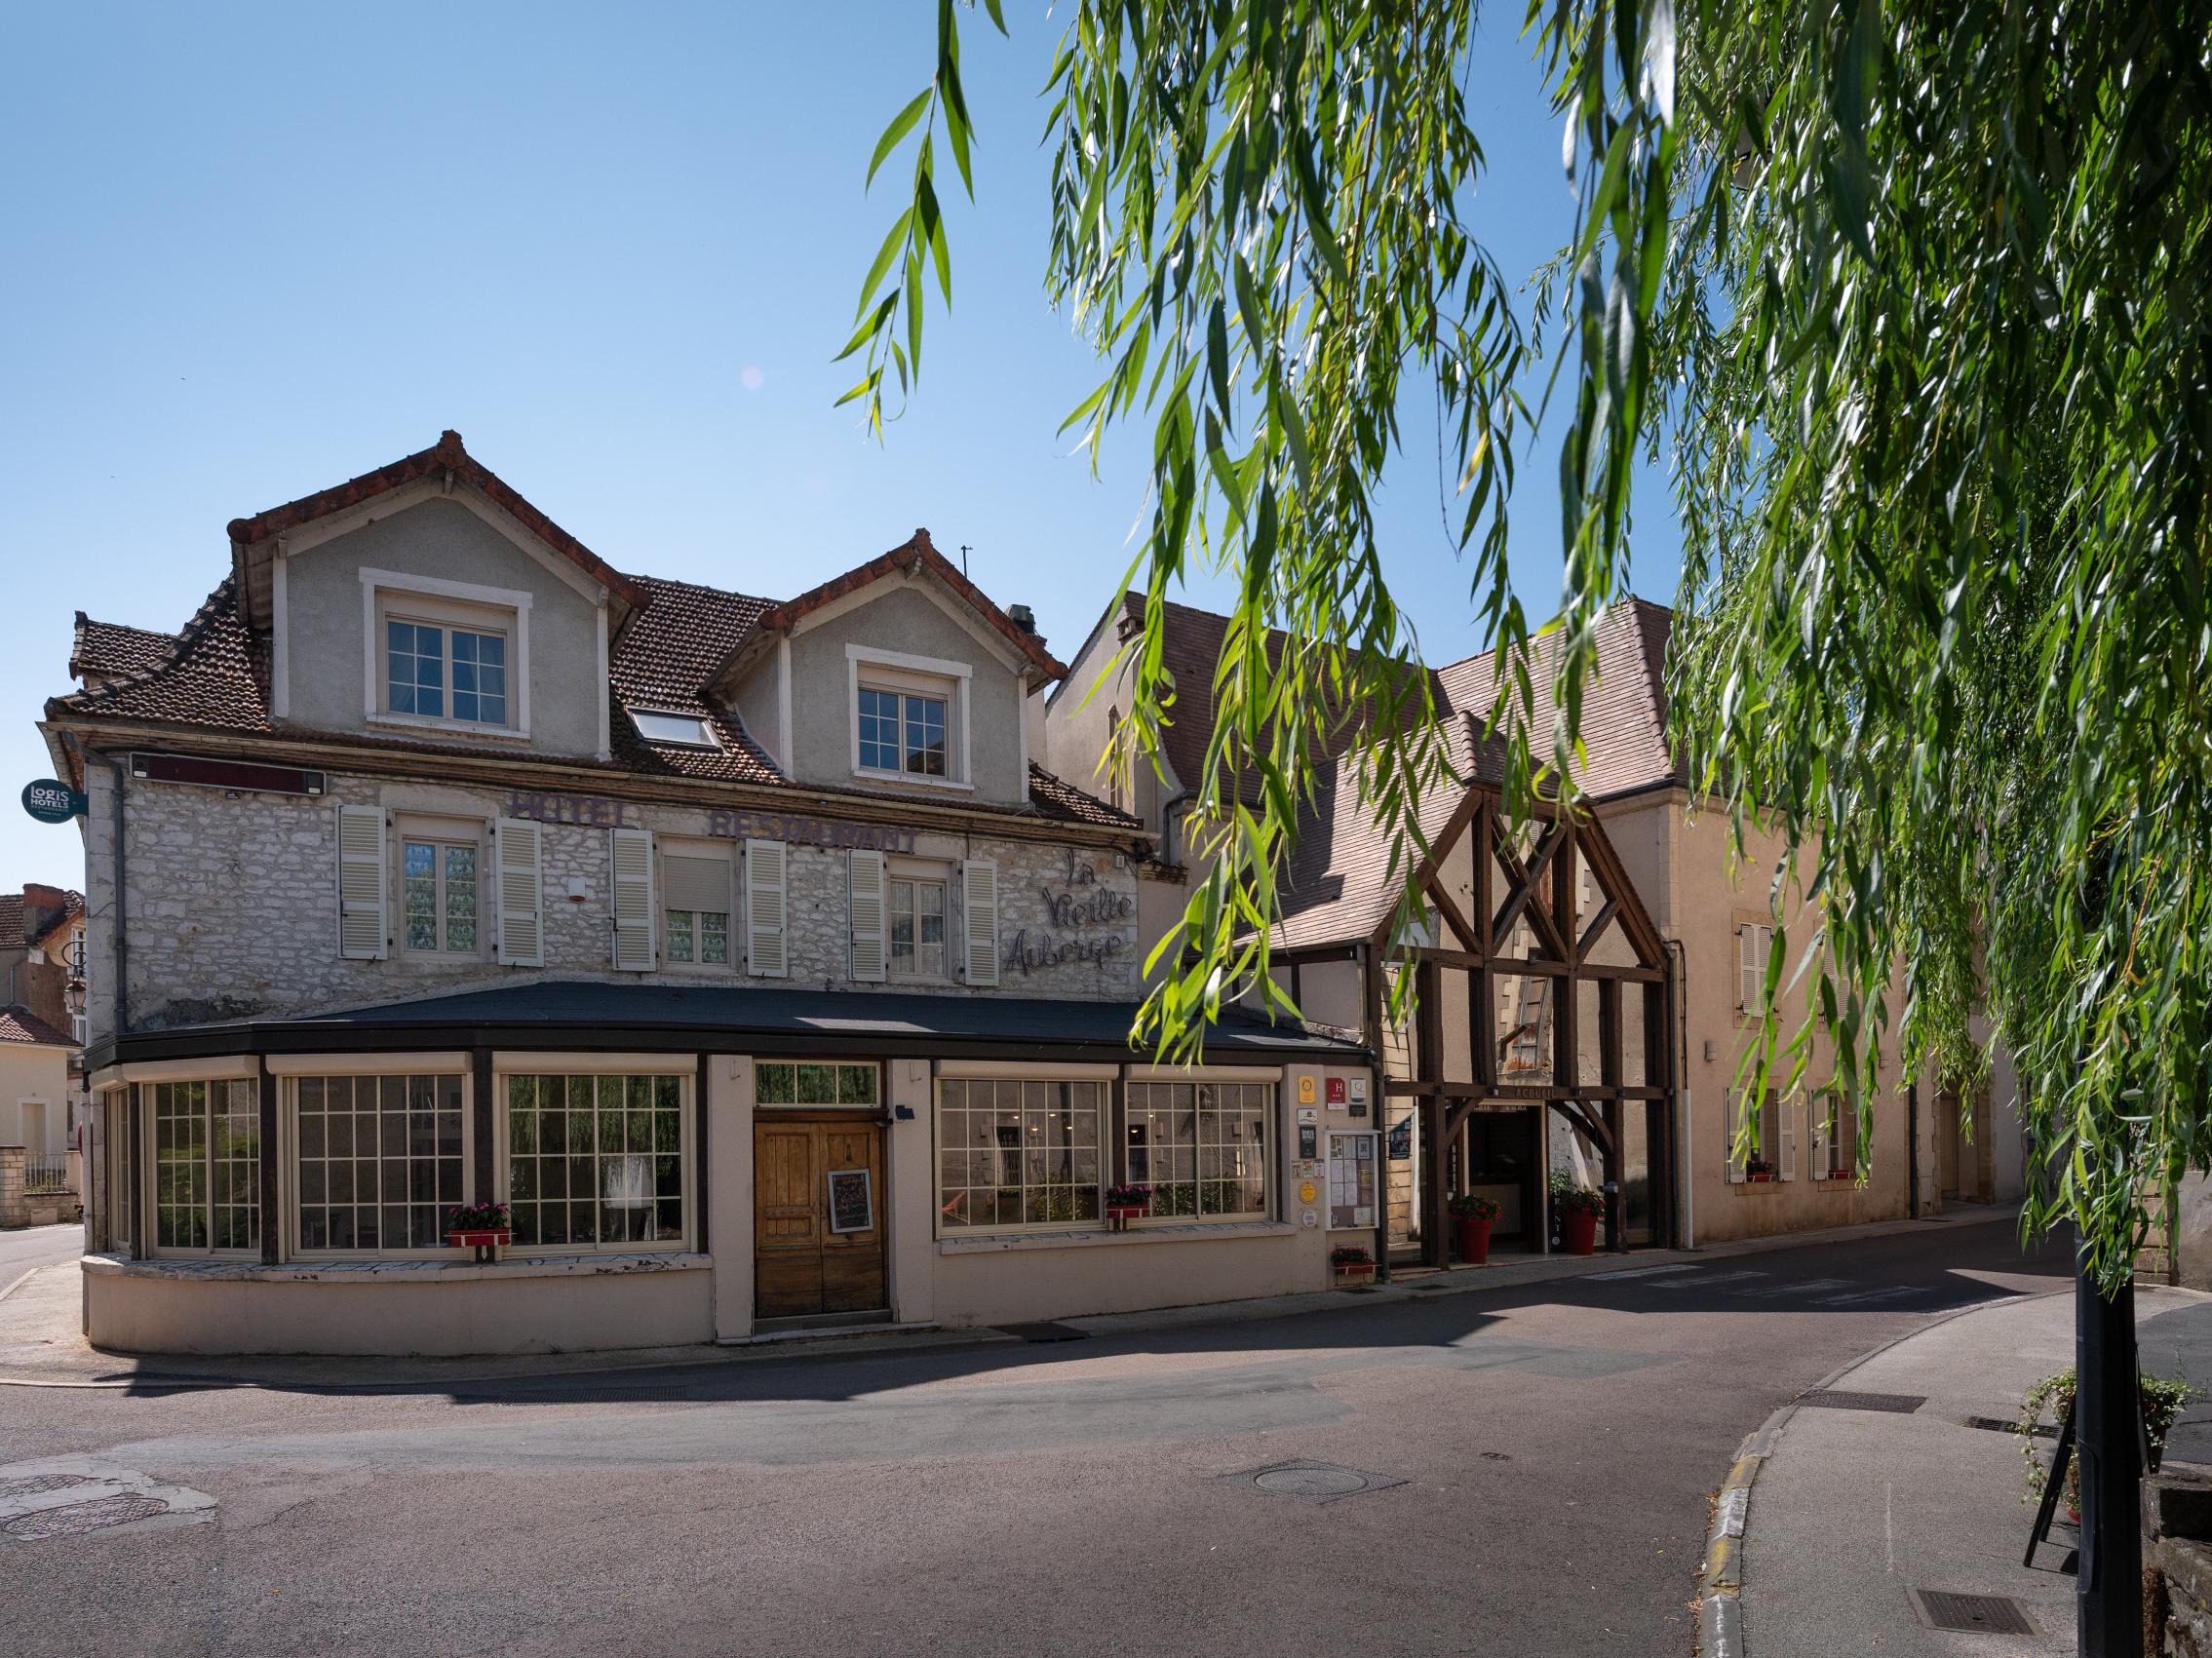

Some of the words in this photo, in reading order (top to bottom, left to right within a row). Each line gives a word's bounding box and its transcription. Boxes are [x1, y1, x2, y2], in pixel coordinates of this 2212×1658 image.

[30, 798, 69, 809] HOTELS
[512, 790, 640, 829] HOTEL
[708, 809, 921, 854] RESTAURANT
[1042, 887, 1137, 928] Vieille
[1004, 928, 1122, 977] Auberge
[1336, 1083, 1343, 1093] H
